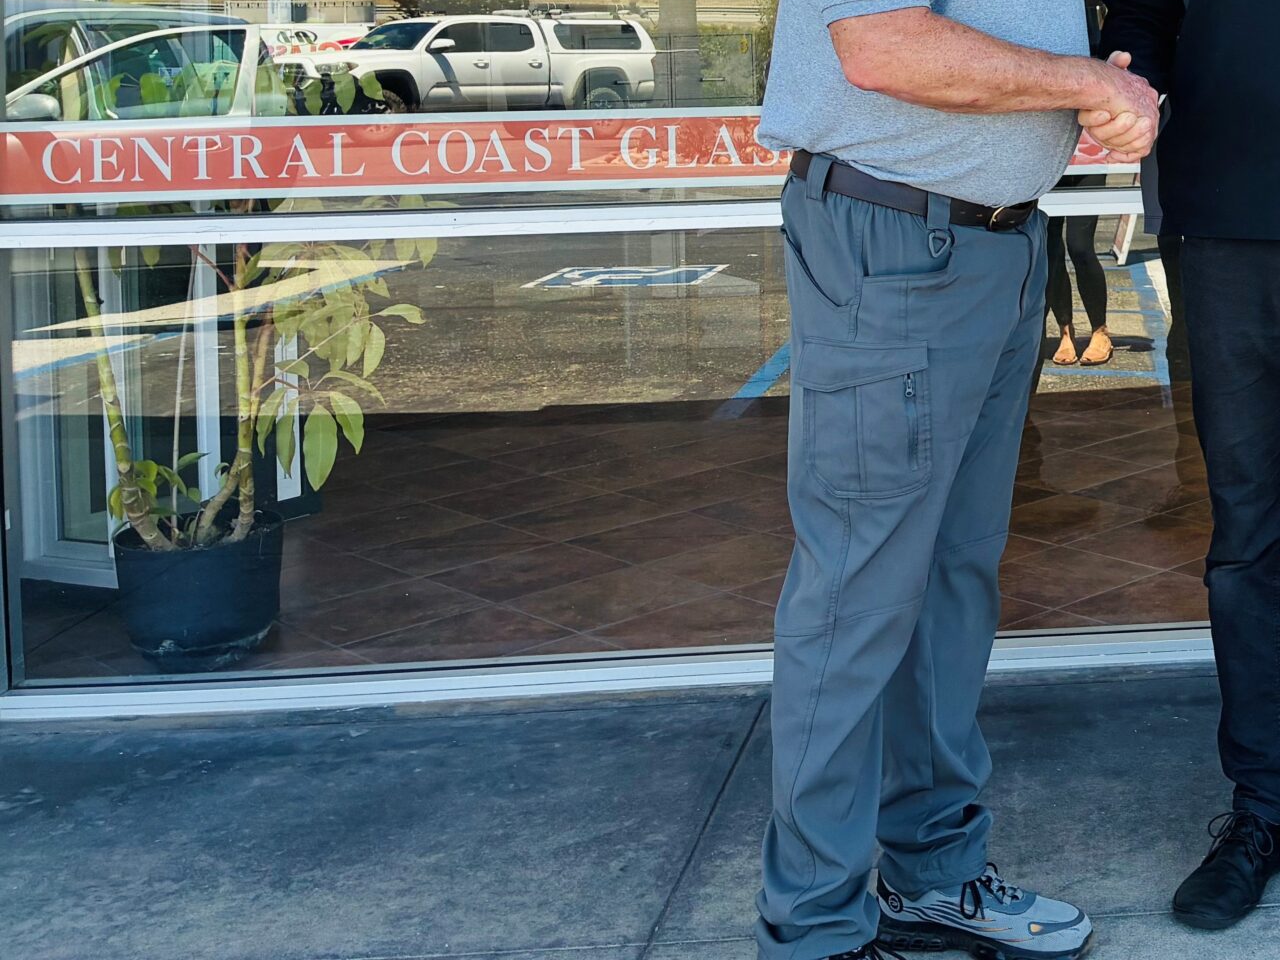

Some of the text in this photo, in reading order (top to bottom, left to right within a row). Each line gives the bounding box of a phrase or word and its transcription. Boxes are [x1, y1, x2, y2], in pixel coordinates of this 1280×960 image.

[41, 122, 791, 185] CENTRAL COAST GLAS
